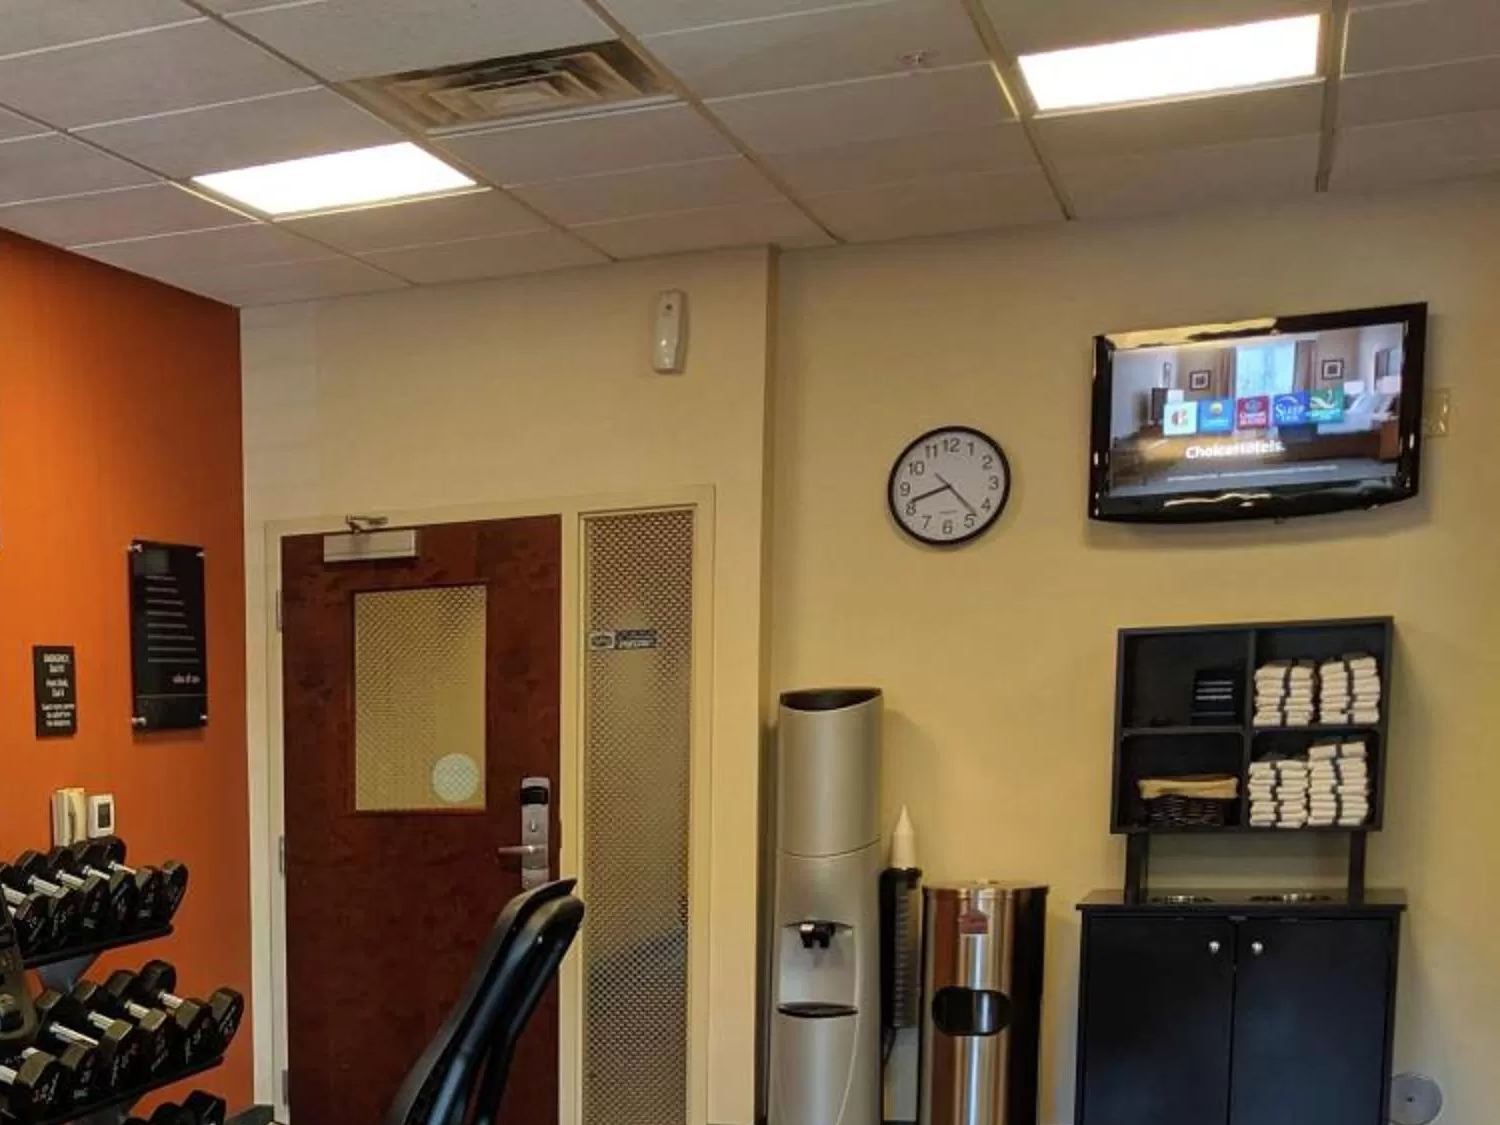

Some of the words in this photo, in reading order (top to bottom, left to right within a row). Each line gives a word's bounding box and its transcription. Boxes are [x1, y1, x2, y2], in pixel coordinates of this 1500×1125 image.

[925, 444, 938, 459] 11
[943, 437, 961, 453] 12
[967, 442, 974, 457] 1
[908, 460, 925, 476] 10
[981, 454, 993, 470] 2
[900, 481, 911, 497] 9
[988, 475, 999, 490] 3
[906, 500, 917, 516] 8
[980, 497, 991, 511] 4
[922, 515, 932, 529] 7
[942, 519, 953, 534] 6
[964, 513, 976, 528] 5
